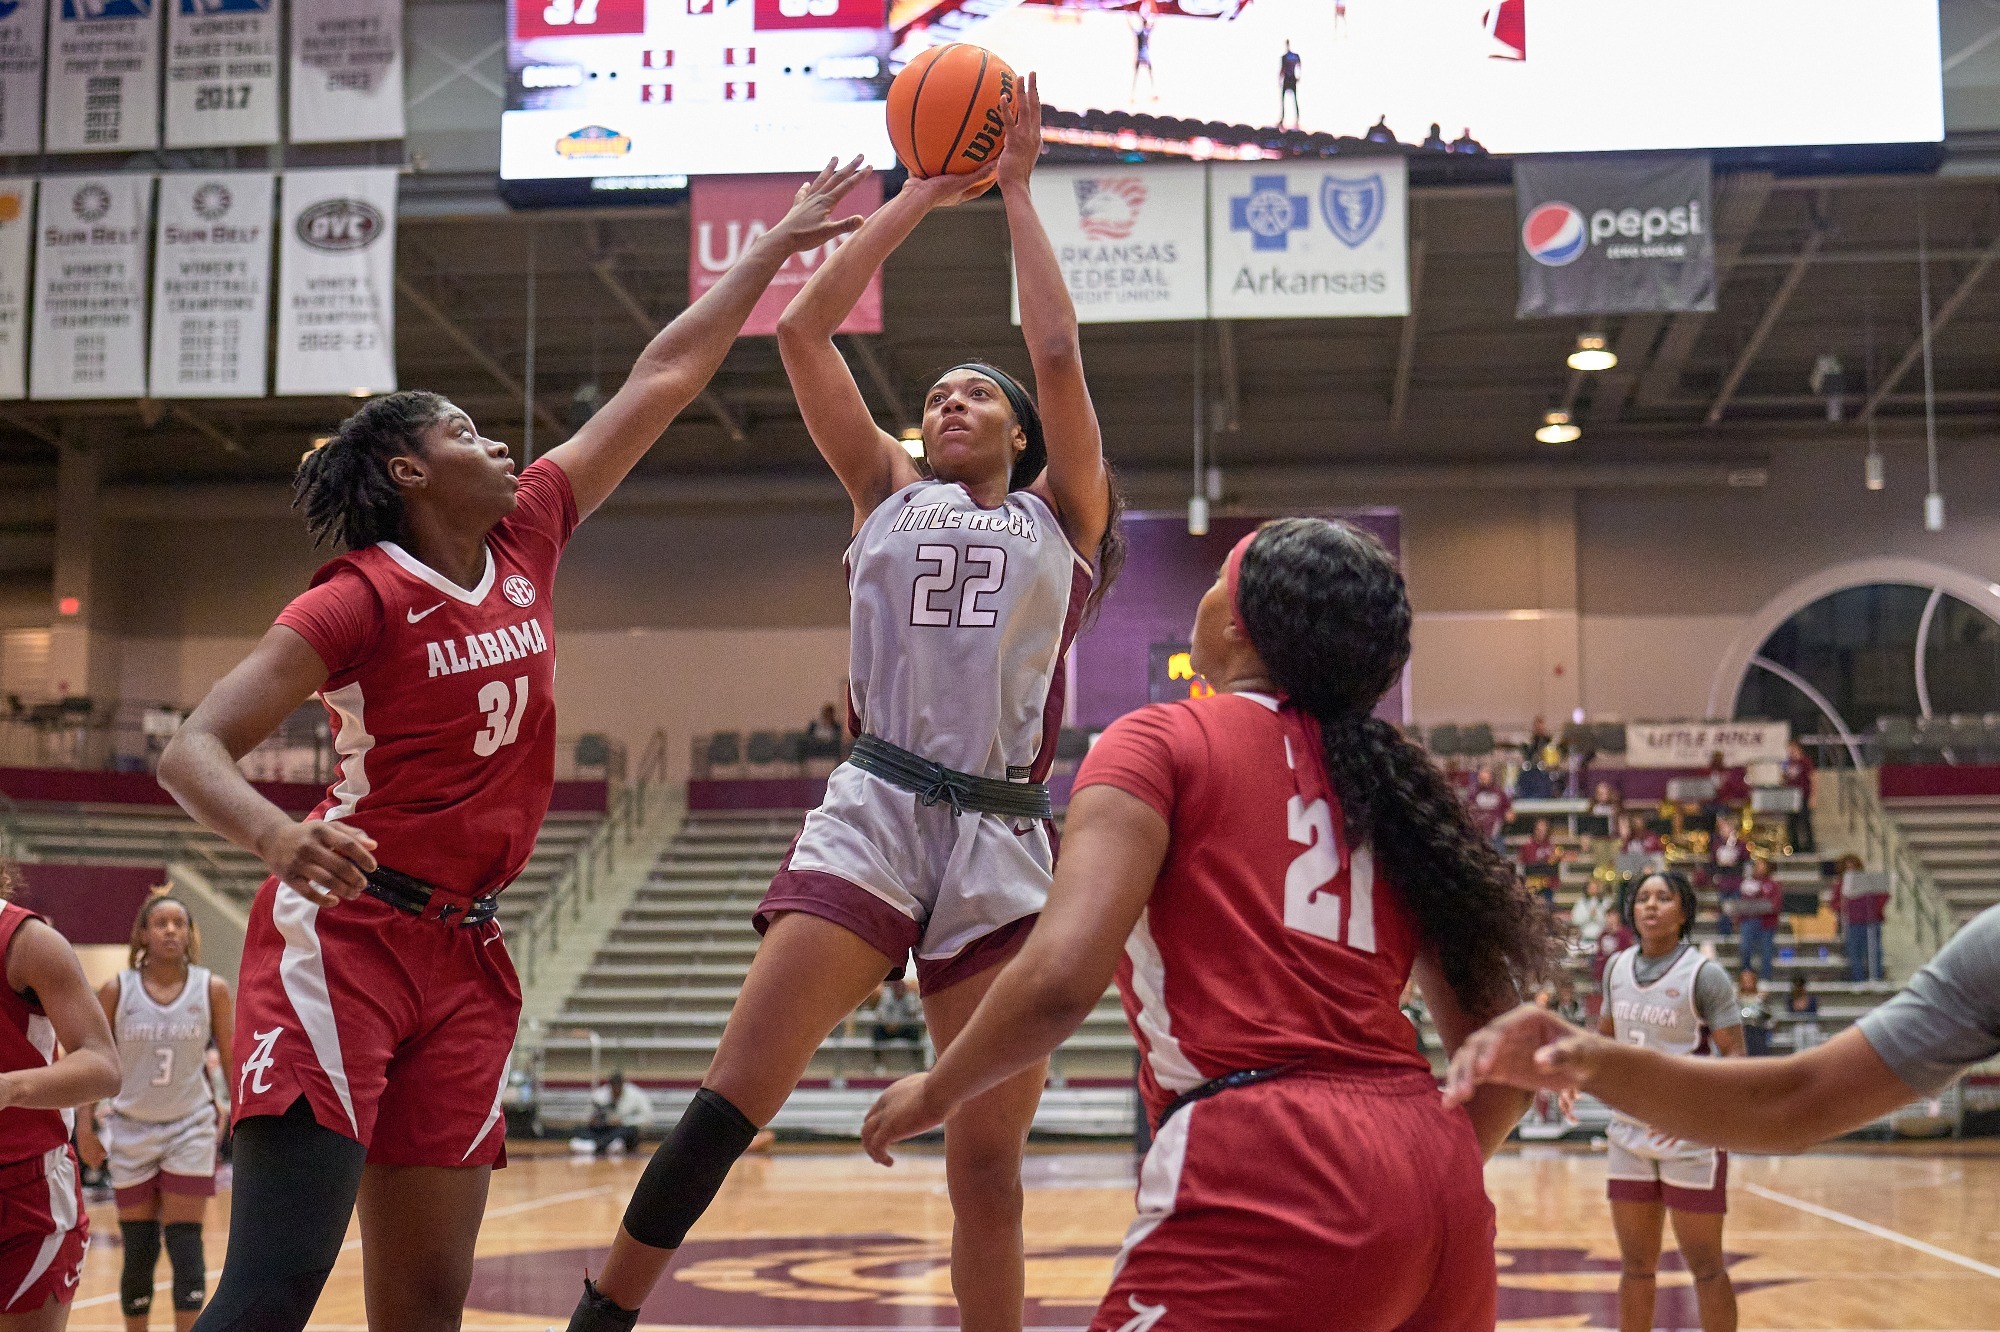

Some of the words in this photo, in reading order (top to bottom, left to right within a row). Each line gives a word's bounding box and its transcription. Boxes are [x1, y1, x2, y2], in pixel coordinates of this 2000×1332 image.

[195, 86, 251, 110] 2017
[961, 70, 1014, 163] Wilon
[1591, 200, 1703, 246] pepsi
[1060, 244, 1178, 264] RKANSAS
[1064, 267, 1168, 289] EDERAL
[1232, 266, 1386, 295] Arkansas
[505, 577, 534, 606] SEC
[909, 543, 1008, 628] 22
[426, 618, 548, 678] ALABAMA
[473, 675, 529, 757] 31
[1284, 794, 1377, 954] 21
[152, 1048, 174, 1087] 3
